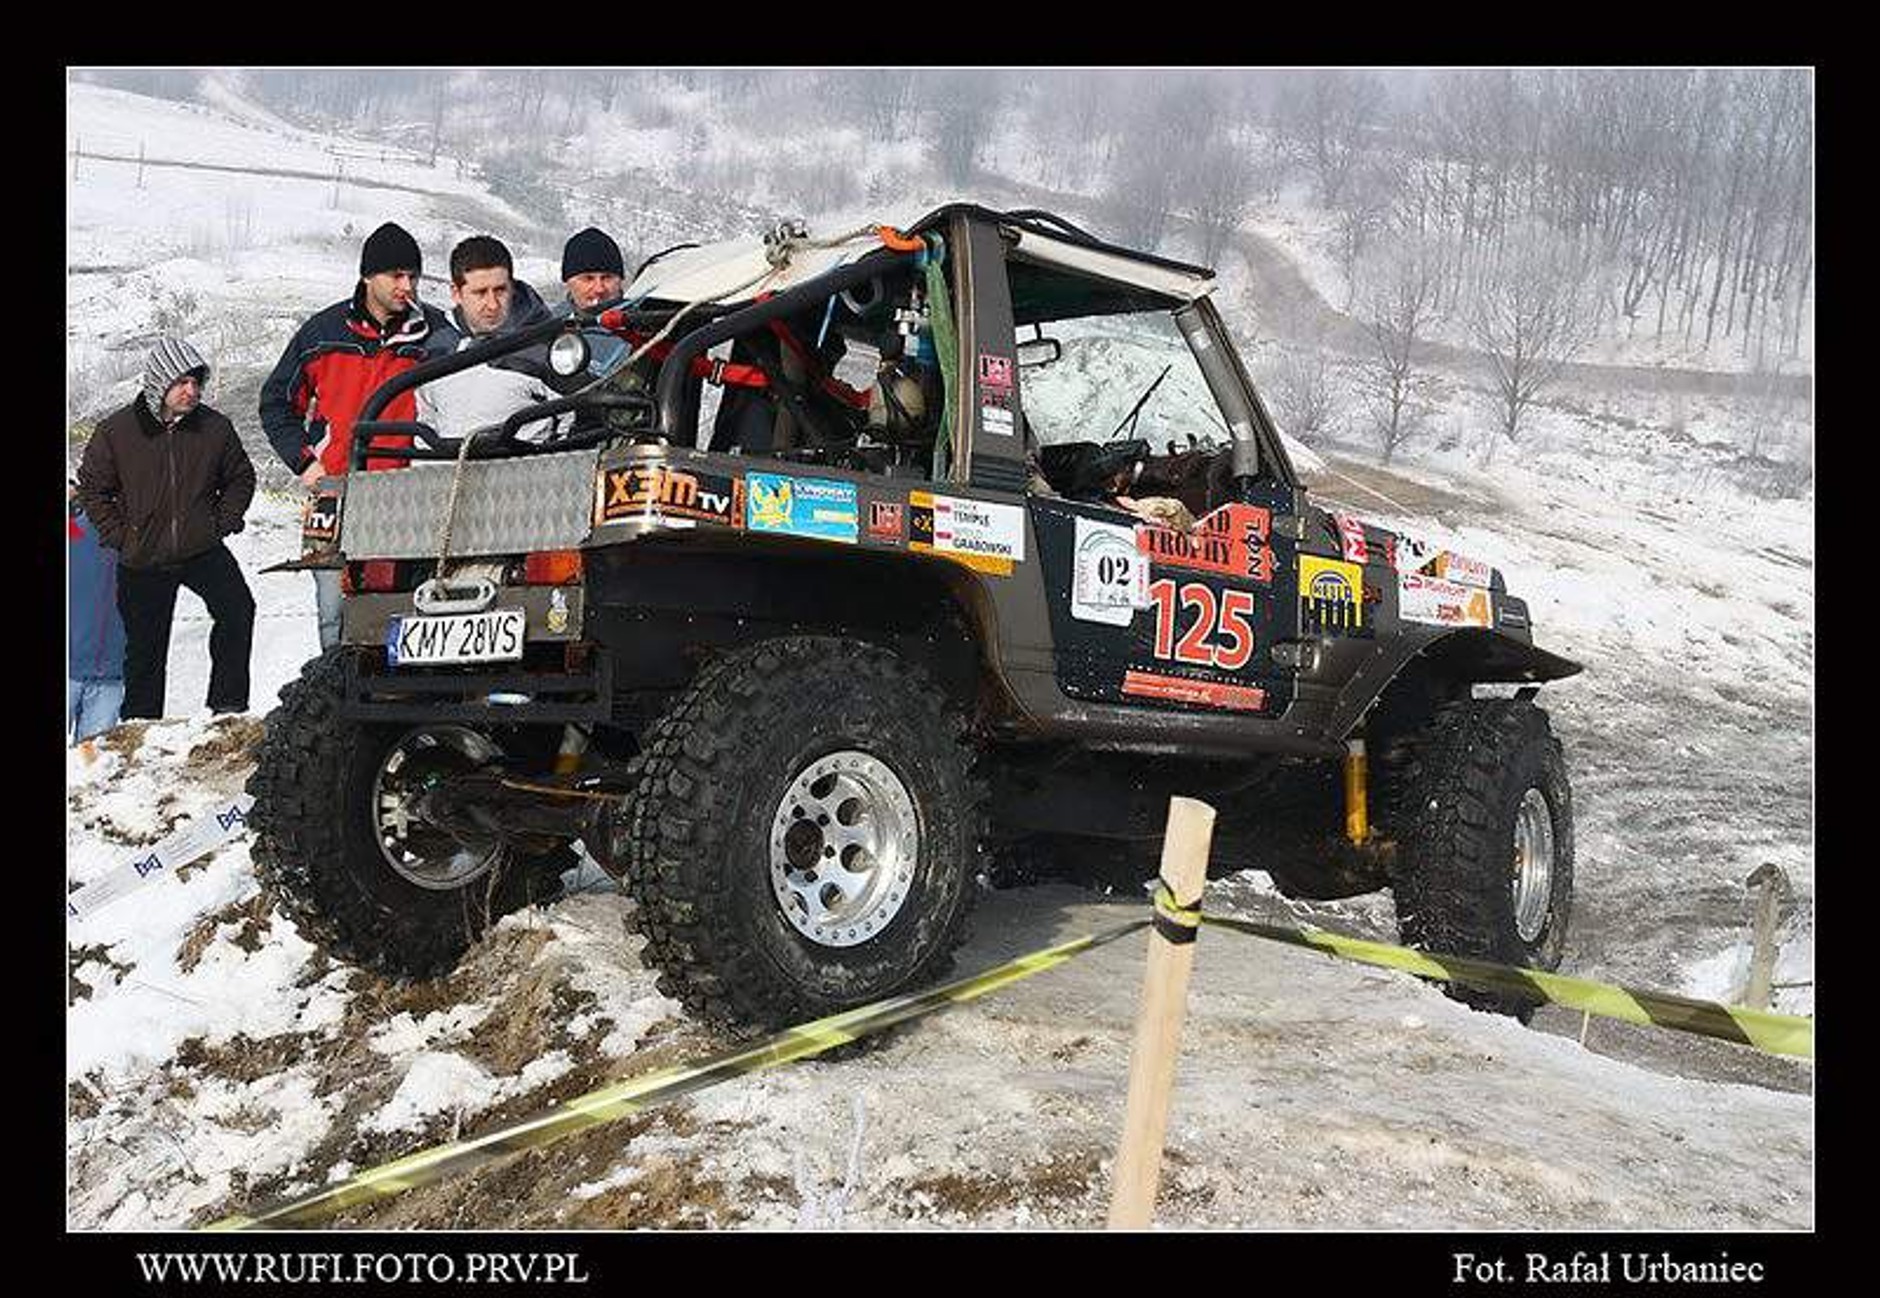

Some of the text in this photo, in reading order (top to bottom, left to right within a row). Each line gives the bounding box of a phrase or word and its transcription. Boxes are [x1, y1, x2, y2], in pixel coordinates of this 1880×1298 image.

[698, 491, 730, 514] TV
[312, 513, 335, 530] TV
[1147, 528, 1233, 565] TROPHY
[1098, 555, 1130, 586] 02
[400, 615, 519, 658] KMY 28VS
[1150, 578, 1255, 669] 125
